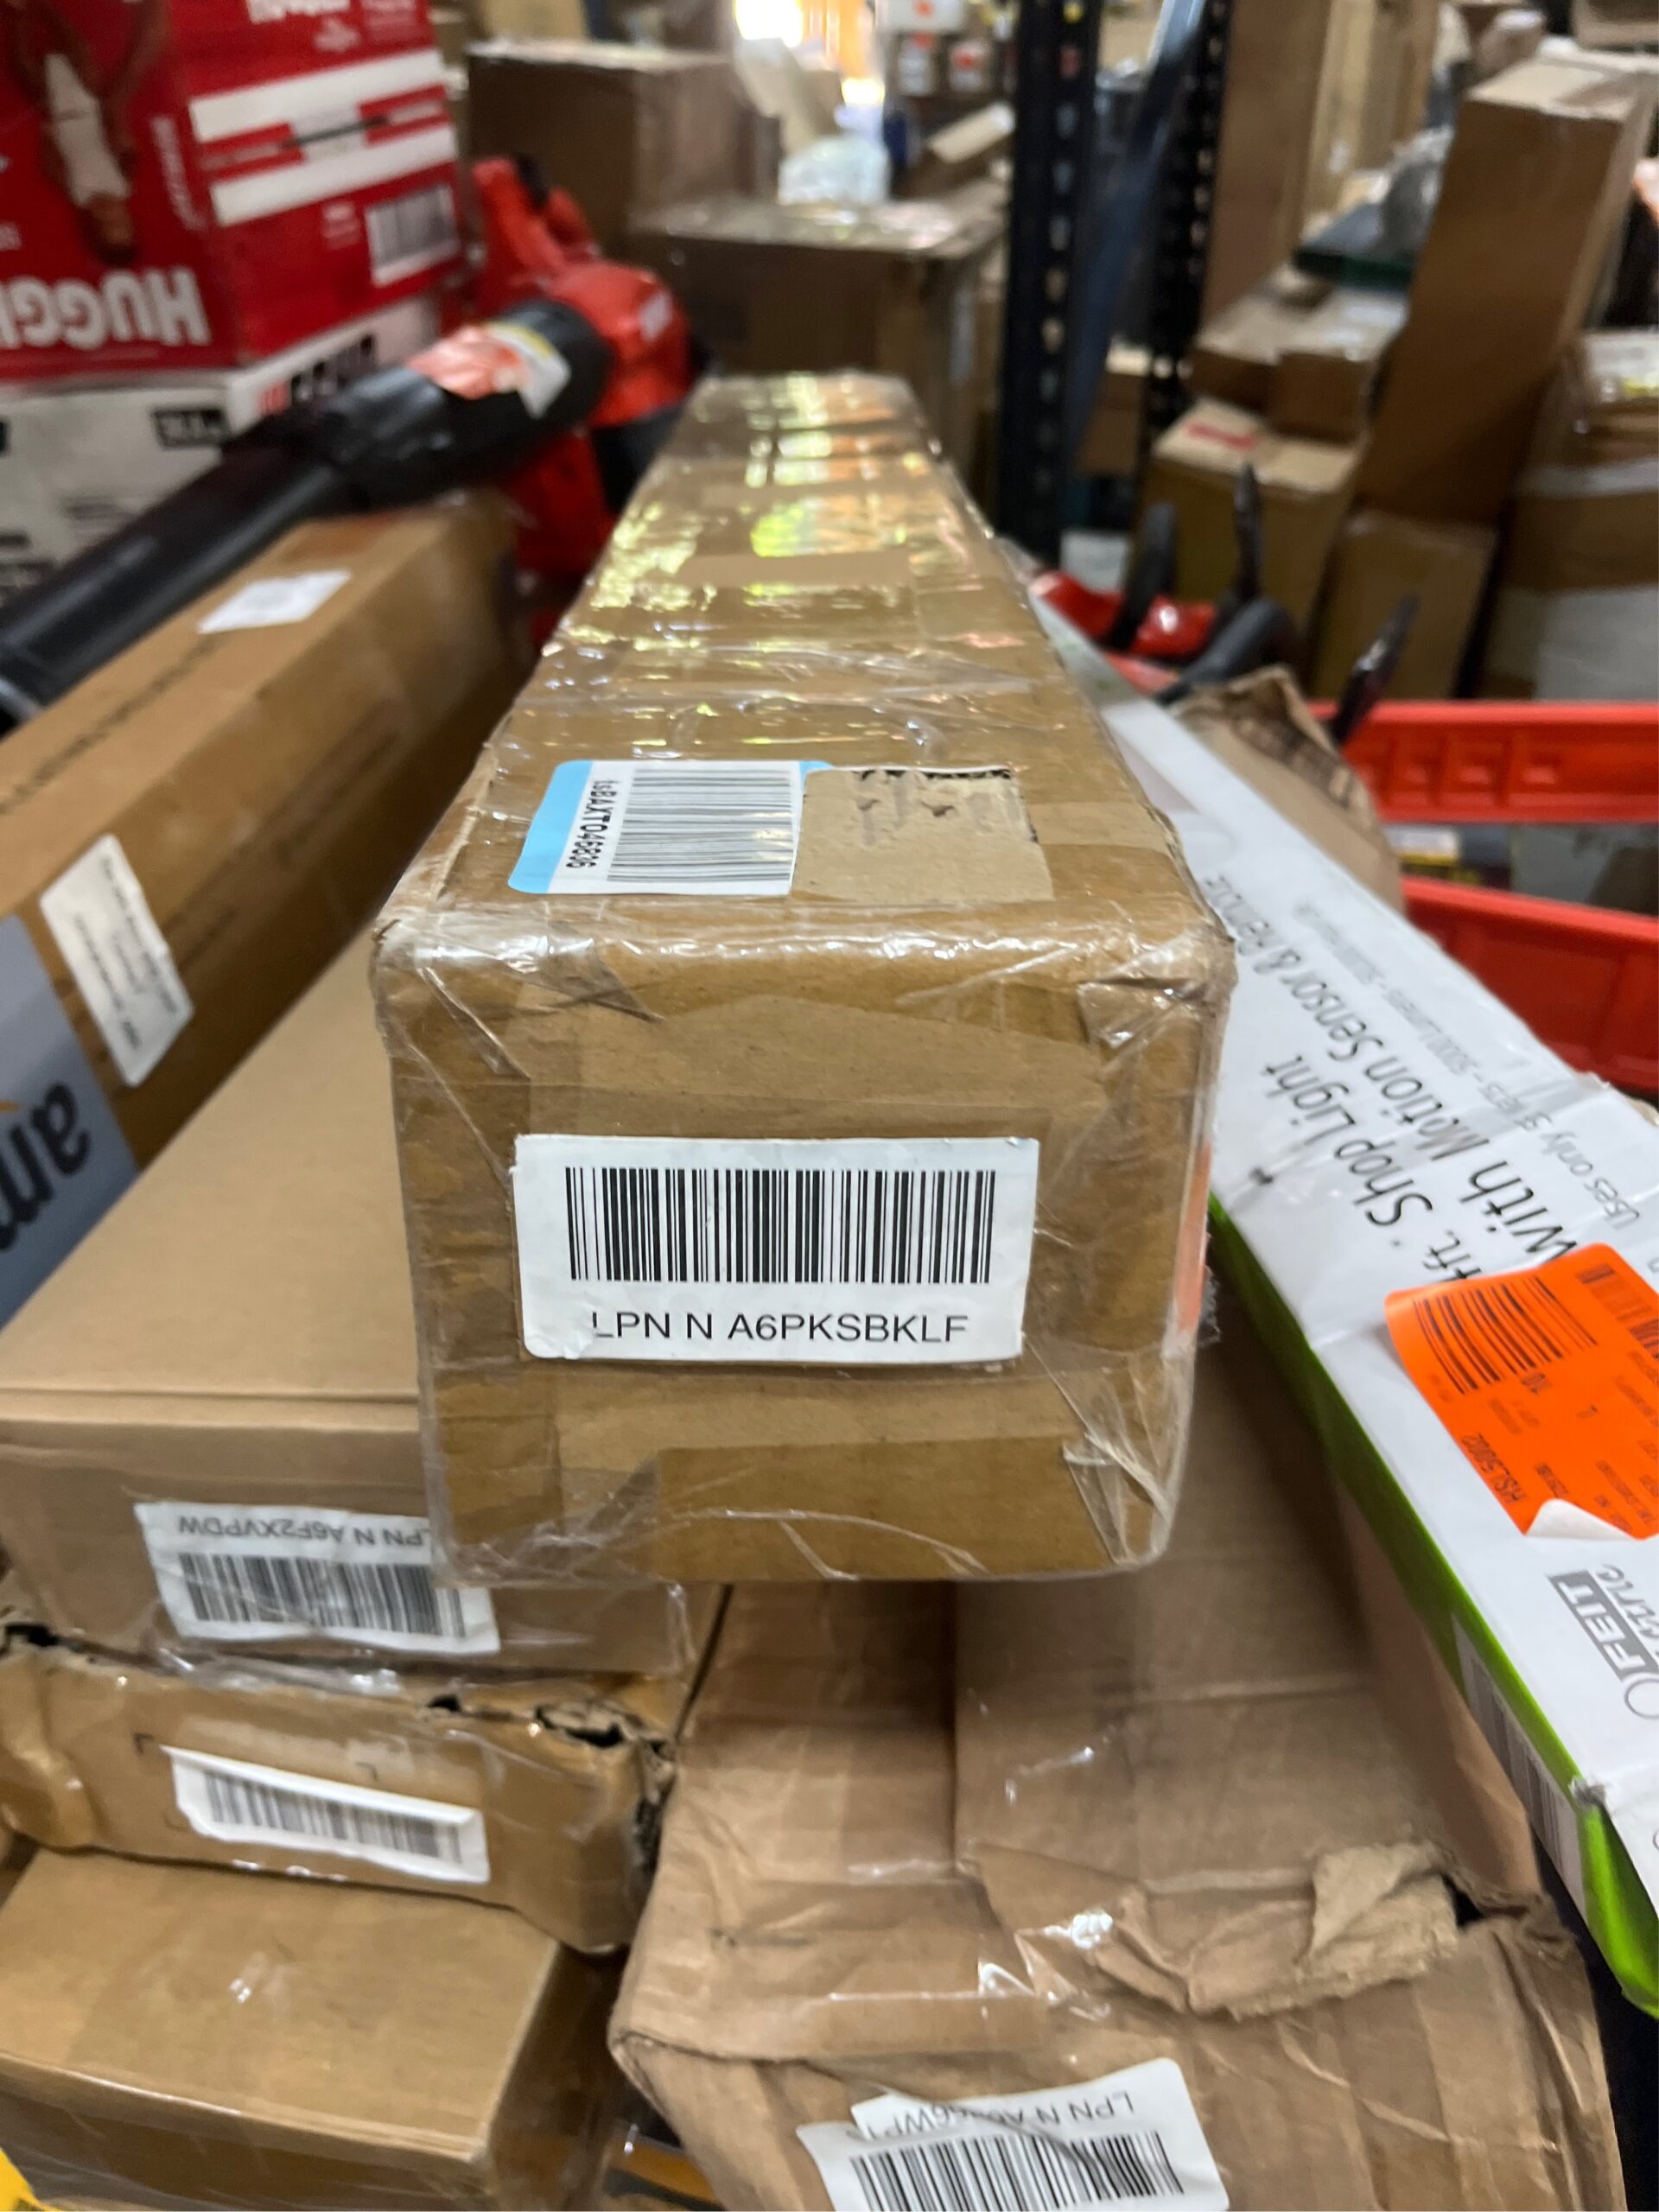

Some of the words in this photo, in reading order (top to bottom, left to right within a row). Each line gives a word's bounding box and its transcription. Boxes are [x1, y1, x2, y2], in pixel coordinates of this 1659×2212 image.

[1280, 972, 1383, 1062] Sensor
[1263, 1056, 1356, 1147] Light
[1363, 1057, 1490, 1160] Motion
[1335, 1141, 1433, 1225] Shop
[1459, 1161, 1577, 1263] with
[1584, 1178, 1640, 1229] Uses
[592, 1312, 671, 1338] LPN
[686, 1313, 713, 1339] N
[728, 1313, 969, 1344] A6PKSBKLF
[354, 1527, 375, 1546] N
[1558, 1580, 1646, 1671] FEIT
[1037, 2103, 1061, 2125] N
[1068, 2090, 1135, 2121] LPN
